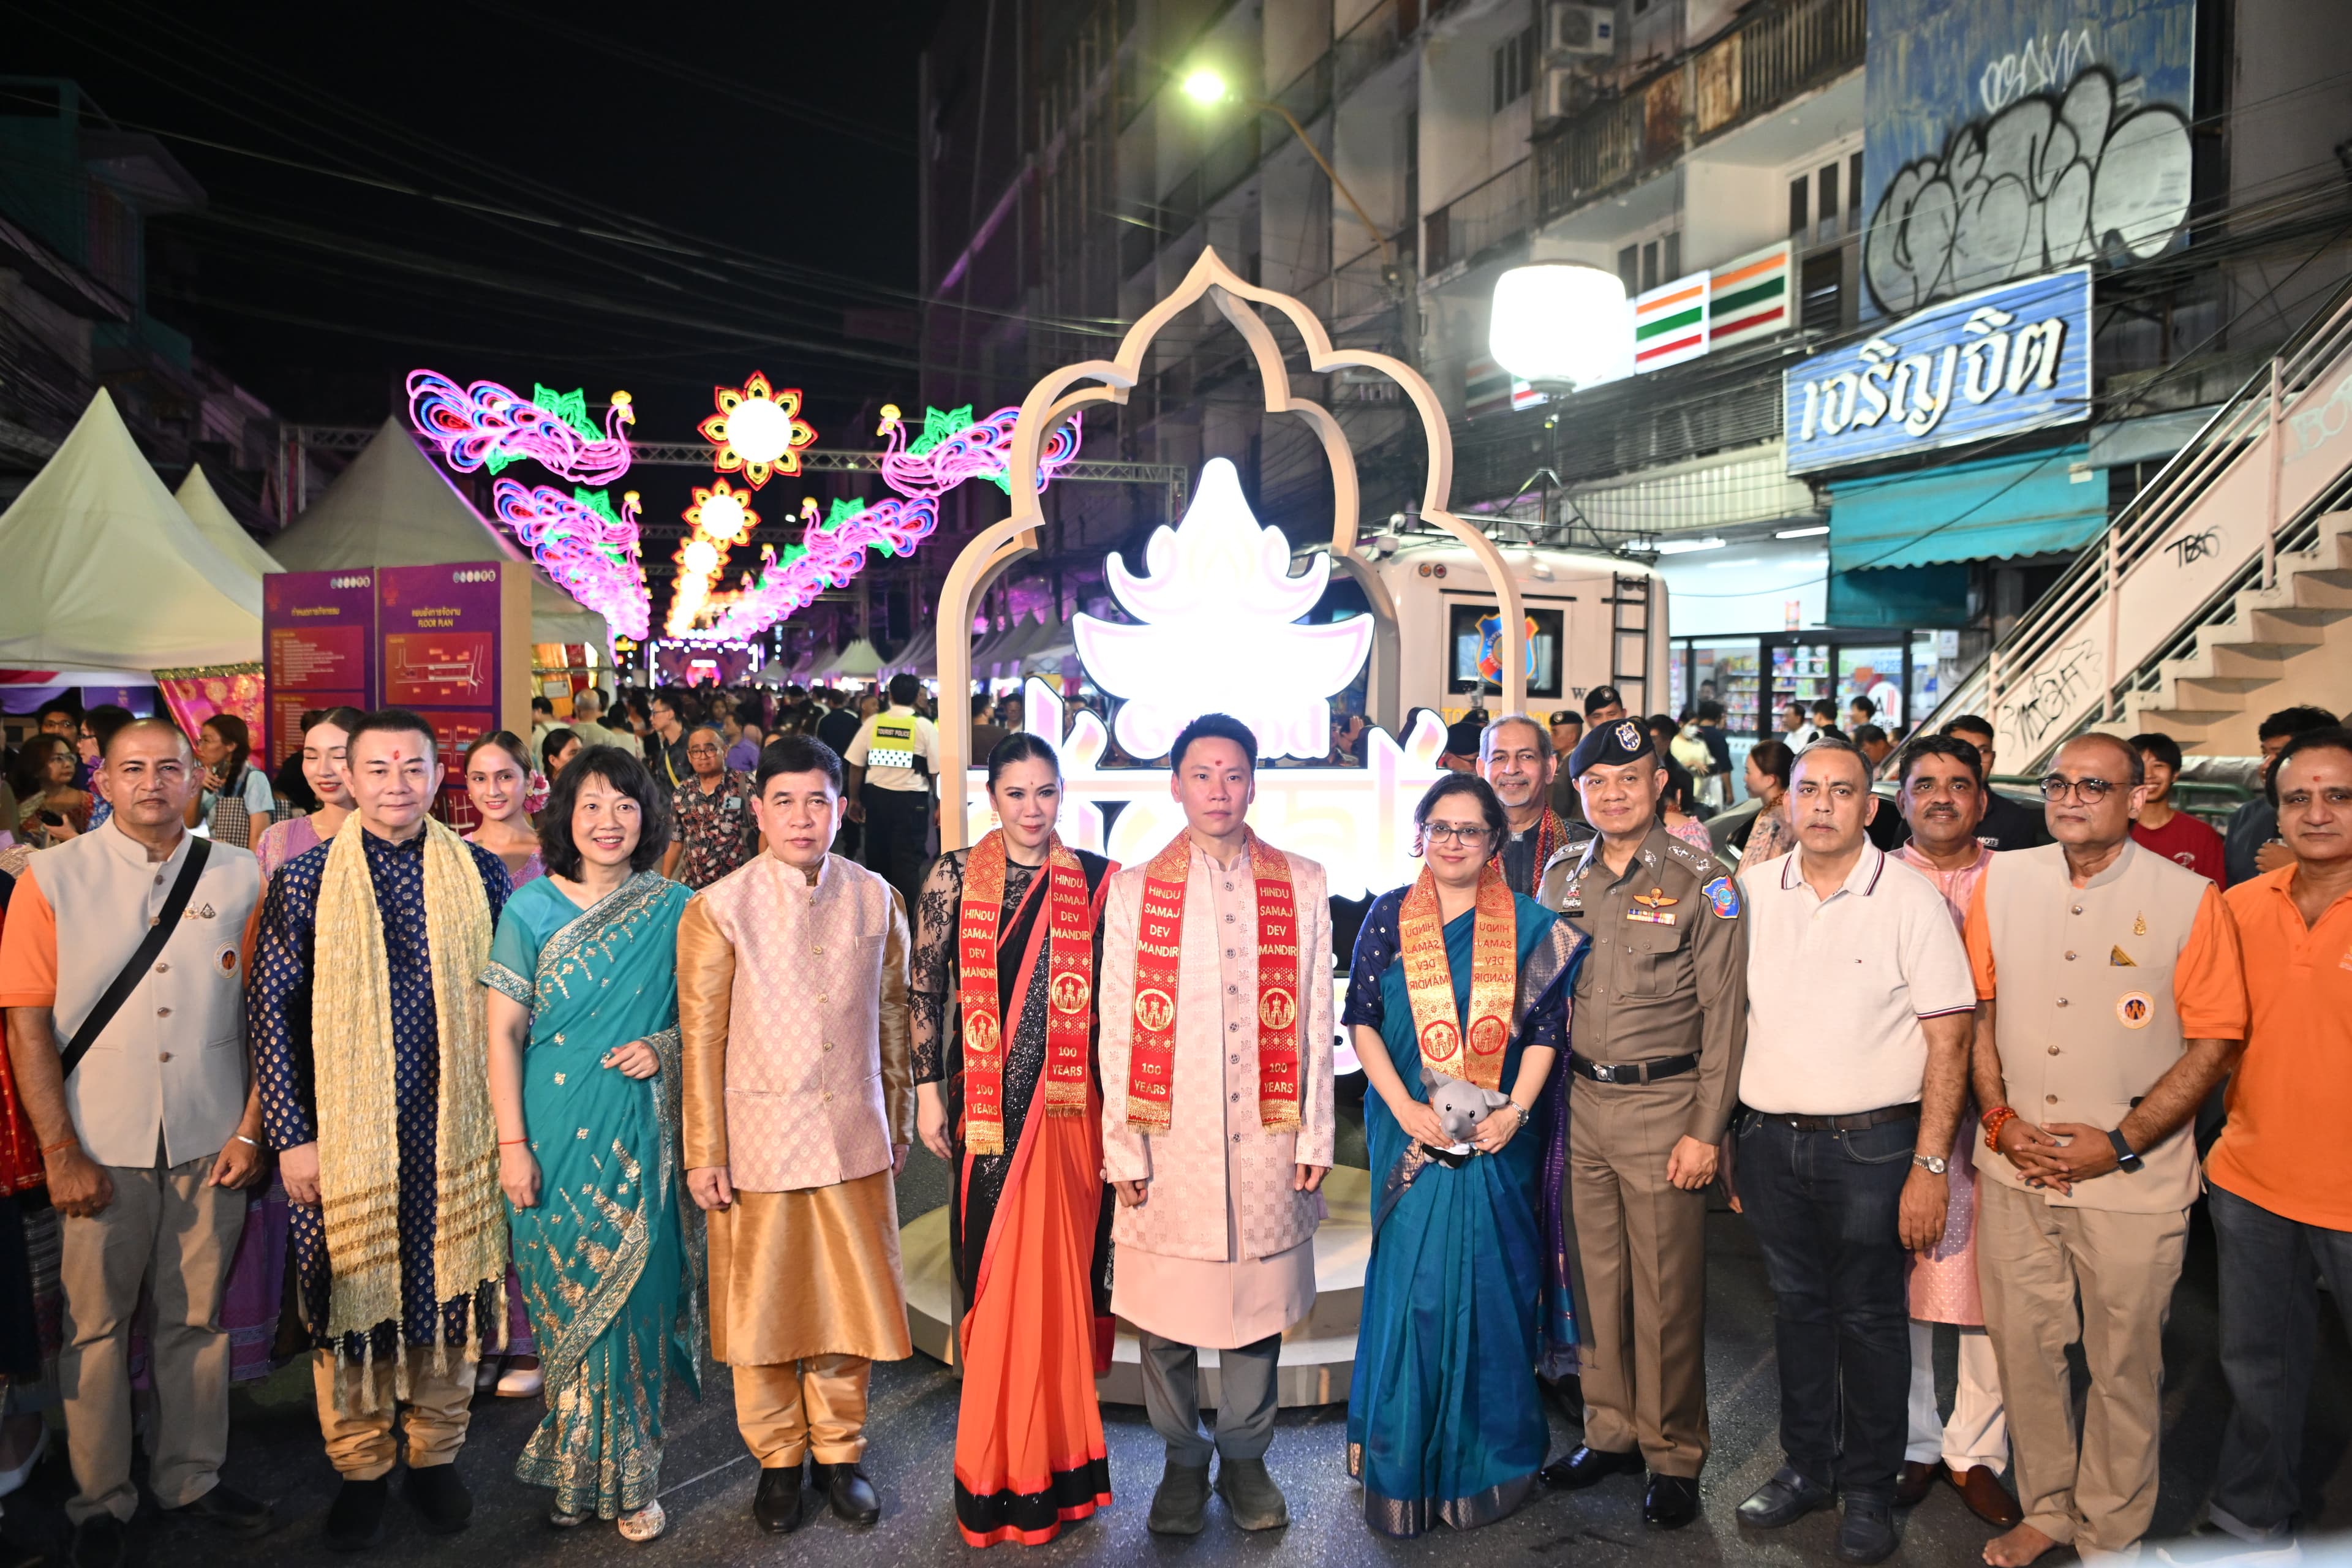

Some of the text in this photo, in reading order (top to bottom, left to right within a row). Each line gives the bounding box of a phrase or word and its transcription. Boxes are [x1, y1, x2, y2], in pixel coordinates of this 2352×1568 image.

[1801, 306, 2068, 439] เจริญจิต
[1055, 873, 1083, 889] HINDU
[1054, 892, 1085, 905] SAMAJ
[1148, 885, 1181, 900] HINDU
[1260, 886, 1289, 899] HINDU
[965, 909, 995, 922] HINDU
[1061, 911, 1079, 922] DEV
[1145, 903, 1179, 919] SAMAJ
[1260, 905, 1292, 918] SAMAJ
[962, 929, 993, 940] SAMAJ
[1052, 929, 1090, 941] MANDIR
[1150, 925, 1170, 938] DEV
[1267, 924, 1286, 937] DEV
[969, 947, 985, 959] DEV
[1139, 940, 1178, 957] MANDIR
[1259, 944, 1297, 957] MANDIR
[962, 967, 996, 979] MANDIR
[1058, 1046, 1076, 1057] 100
[1052, 1065, 1082, 1077] YEARS
[1142, 1063, 1161, 1075] 100
[1269, 1063, 1287, 1074] 100
[976, 1084, 993, 1096] 100
[1134, 1080, 1166, 1095] YEARS
[1264, 1082, 1293, 1094] YEARS
[972, 1104, 997, 1115] YEARS
